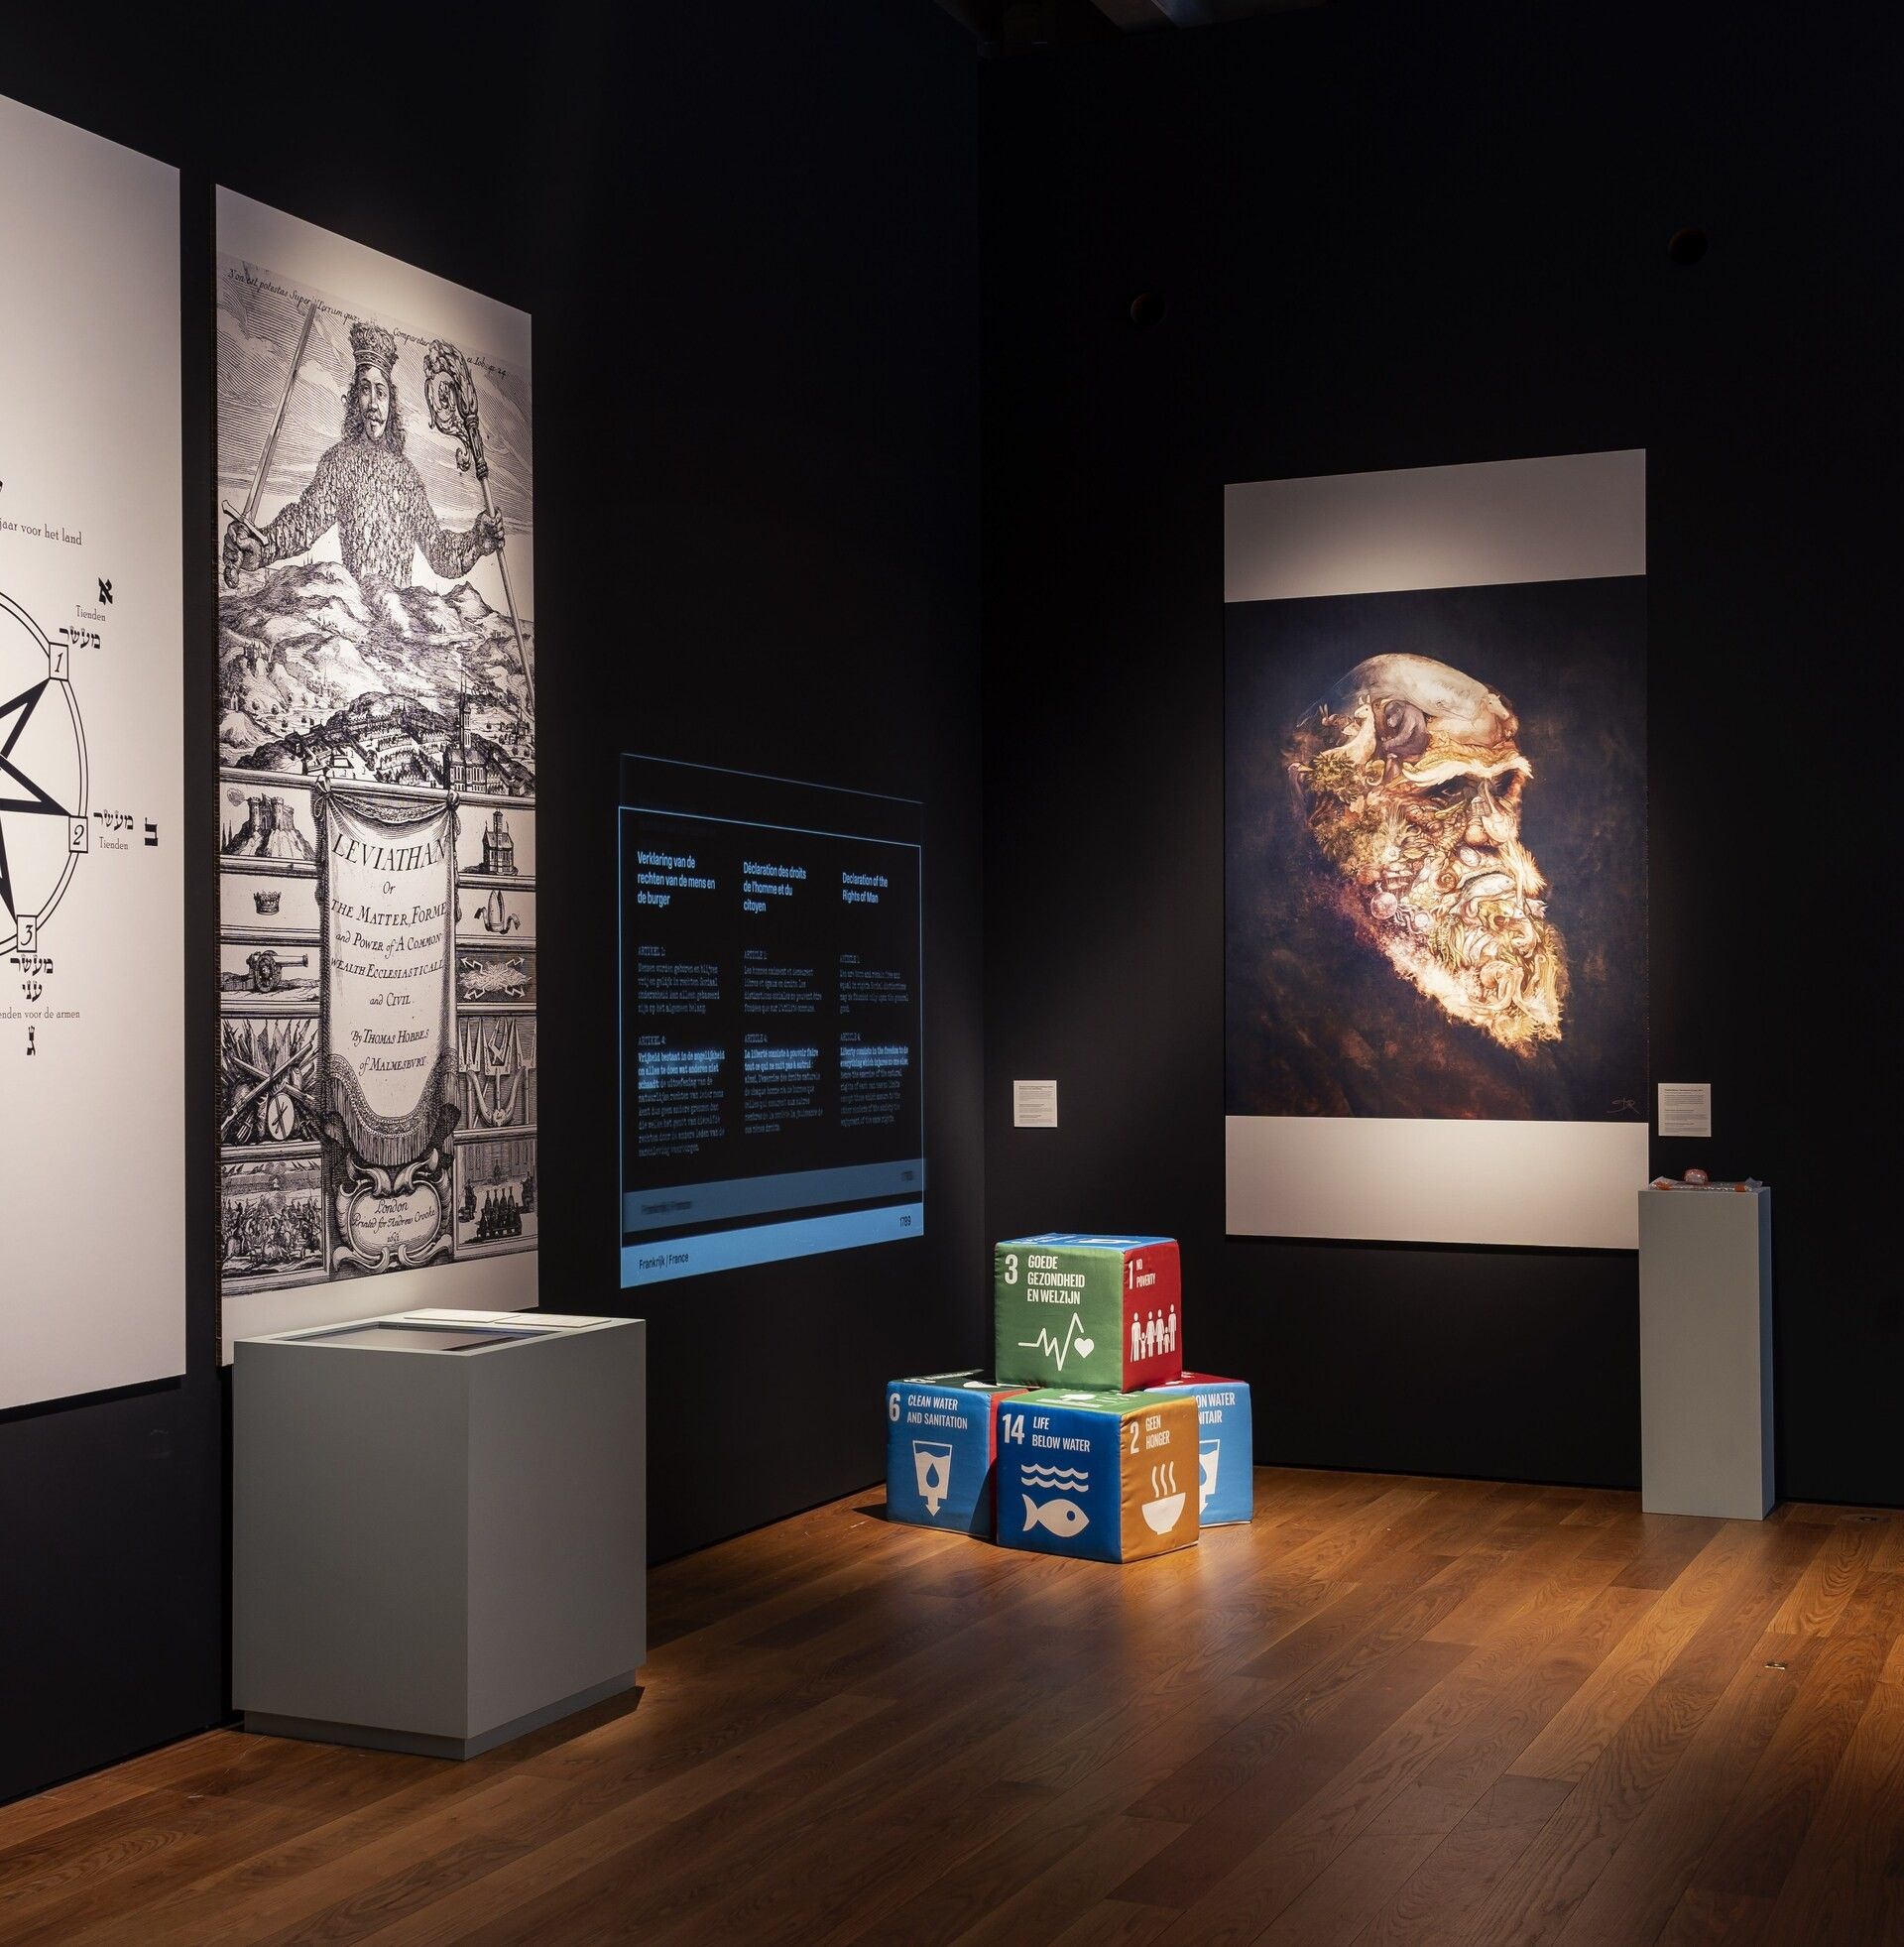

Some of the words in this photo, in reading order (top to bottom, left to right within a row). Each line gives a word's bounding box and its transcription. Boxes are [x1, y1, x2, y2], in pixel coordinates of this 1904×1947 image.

[20, 524, 42, 537] voor
[44, 523, 60, 541] het
[61, 527, 82, 546] land
[98, 576, 113, 605] א
[76, 605, 106, 622] Tienden
[55, 652, 63, 672] 1
[72, 824, 84, 845] 2
[144, 817, 159, 846] ב
[99, 836, 129, 850] Tienden
[331, 833, 446, 872] LEVIATHAN
[637, 851, 672, 869] Verklaring
[673, 857, 686, 868] van
[686, 855, 696, 869] de
[637, 871, 664, 886] rechten
[665, 876, 678, 887] van
[678, 874, 687, 887] de
[688, 878, 706, 889] mens
[707, 879, 716, 889] en
[744, 861, 777, 877] Déclaration
[777, 865, 789, 878] des
[789, 866, 806, 880] droits
[843, 872, 874, 887] Declaration
[873, 875, 880, 887] of
[879, 876, 889, 888] the
[383, 881, 397, 895] Or
[744, 881, 752, 892] de
[777, 885, 784, 895] et
[784, 884, 793, 896] du
[843, 890, 861, 904] Rights
[860, 891, 867, 902] of
[866, 892, 879, 904] Man
[637, 891, 647, 904] de
[648, 891, 670, 908] burger
[744, 898, 767, 914] citoyen
[331, 899, 354, 918] THE
[412, 902, 446, 924] FORME
[20, 924, 34, 946] 3
[335, 930, 351, 943] and
[353, 932, 384, 951] POWER
[385, 938, 396, 959] of
[396, 936, 405, 951] A
[331, 957, 365, 976] WEALTH
[370, 994, 383, 1006] and
[25, 1010, 42, 1019] voor
[44, 1006, 55, 1019] de
[57, 1010, 80, 1019] armen
[351, 1031, 362, 1047] By
[363, 1029, 397, 1044] THOMAS
[398, 1029, 429, 1043] HOBBES
[358, 1056, 370, 1076] of
[374, 1199, 409, 1214] London
[639, 1255, 665, 1270] Frankrijk
[668, 1253, 689, 1265] France
[1005, 1254, 1018, 1285] 3
[1027, 1255, 1058, 1270] GOEDE
[1027, 1272, 1085, 1288] GEZONDHEID
[1128, 1260, 1133, 1289] 1
[1135, 1258, 1143, 1271] NO
[1135, 1273, 1156, 1287] POVERTY
[1026, 1288, 1039, 1302] EN
[1040, 1289, 1081, 1305] WELZIJN
[889, 1393, 901, 1422] 6
[907, 1395, 932, 1408] CLEAN
[933, 1396, 959, 1411] WATER
[1207, 1392, 1236, 1406] WATER
[906, 1411, 922, 1424] AND
[924, 1412, 968, 1430] SANITATION
[1002, 1413, 1024, 1445] 14
[1032, 1415, 1049, 1430] LIFE
[1031, 1434, 1061, 1450] BELOW
[1062, 1437, 1090, 1453] WATER
[1130, 1421, 1139, 1455] 2
[1145, 1414, 1161, 1431] GEEN
[1145, 1430, 1170, 1450] HONGER
